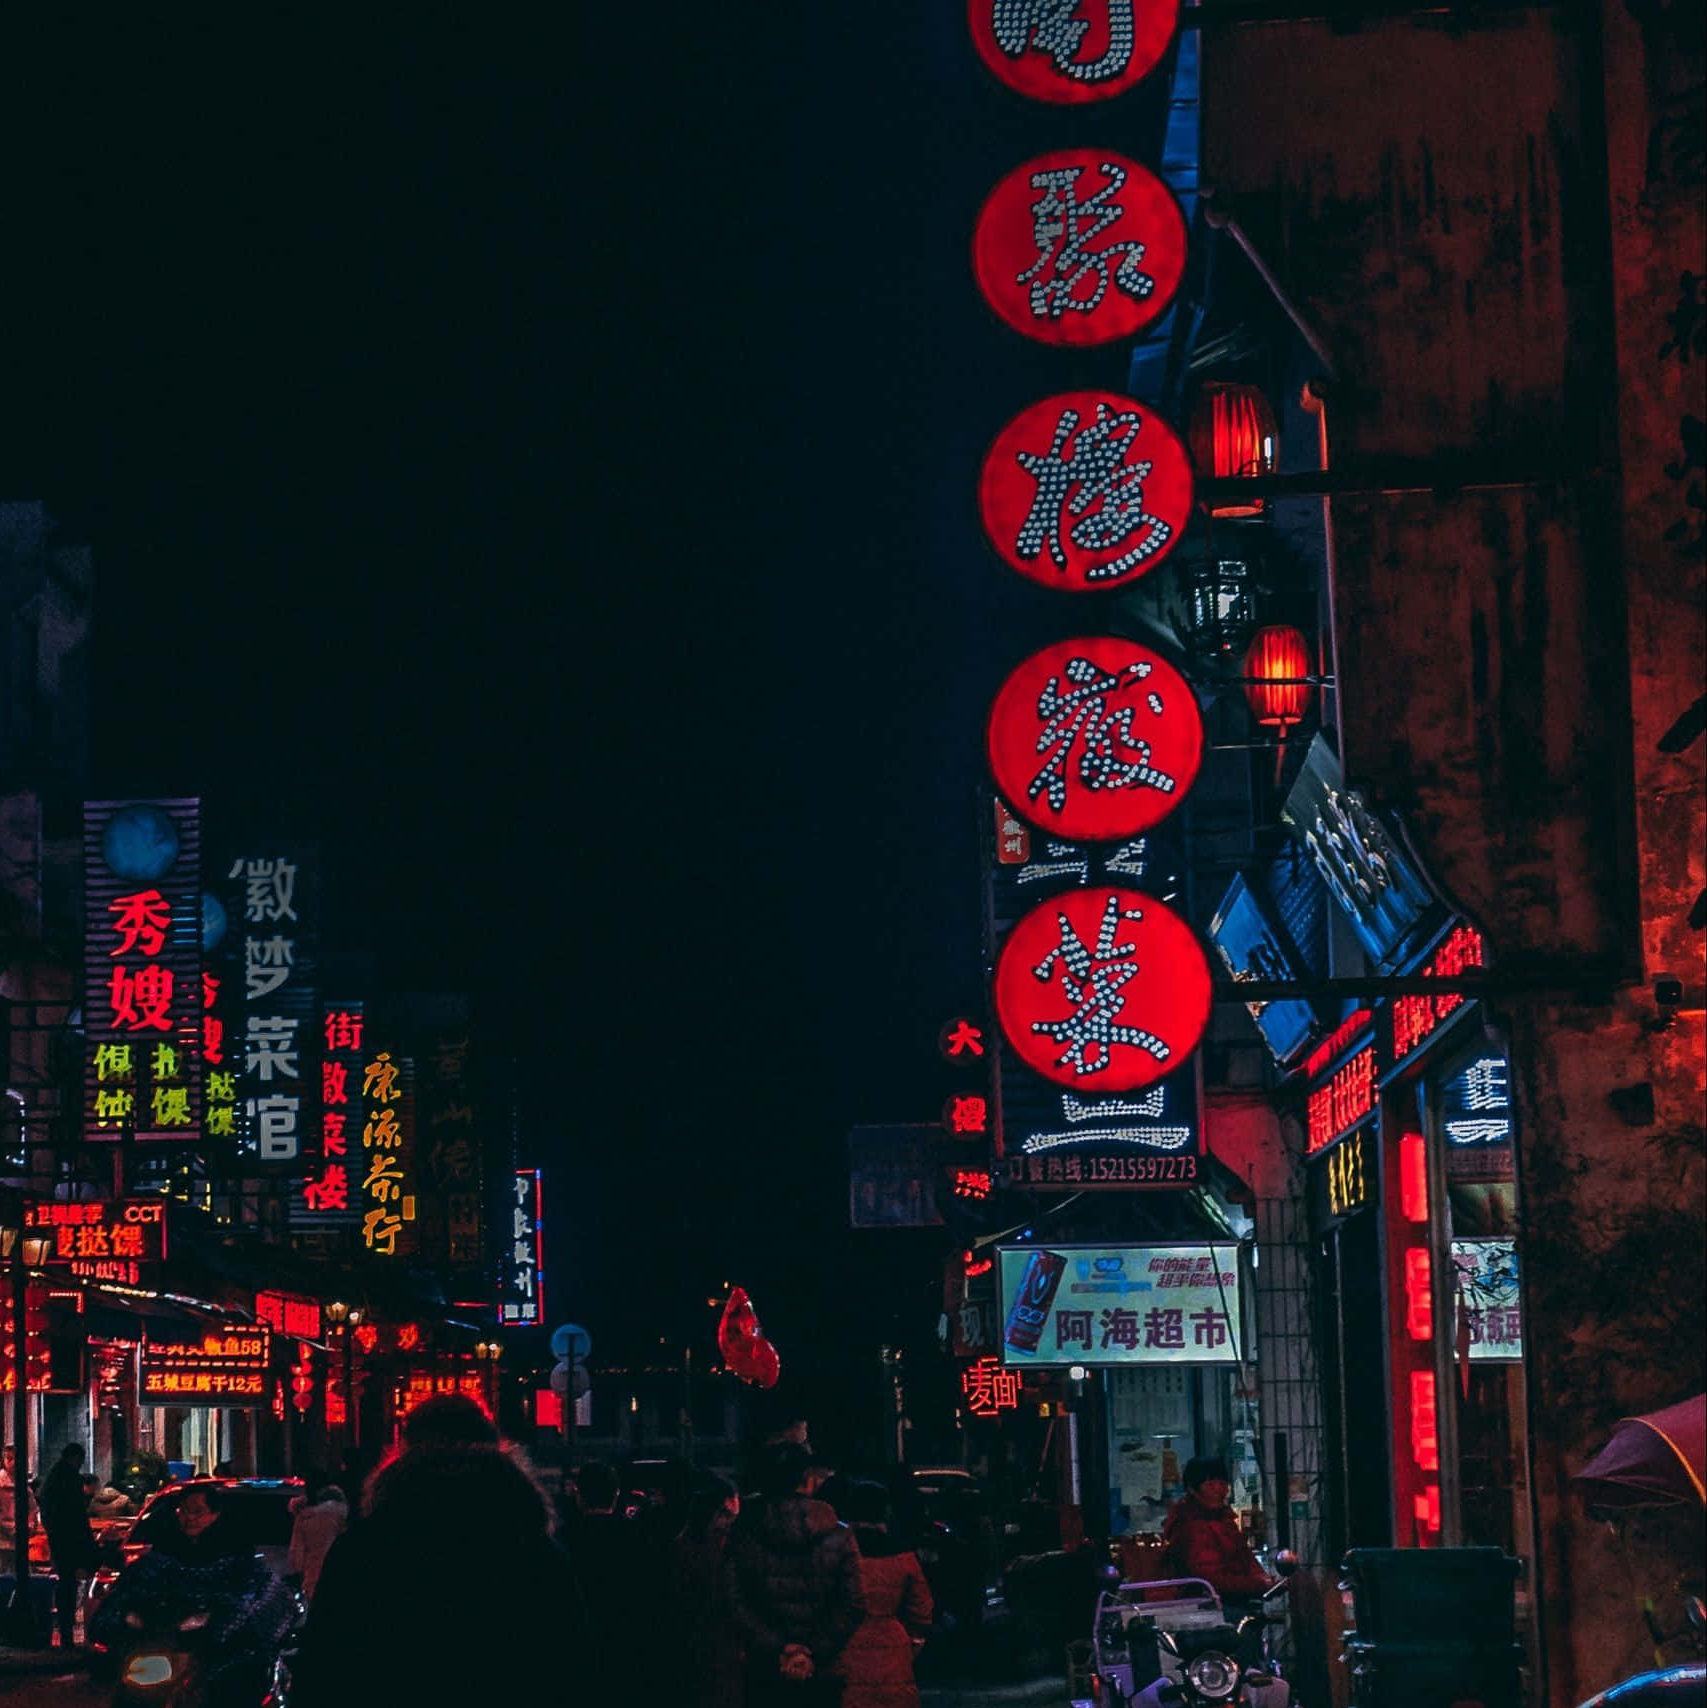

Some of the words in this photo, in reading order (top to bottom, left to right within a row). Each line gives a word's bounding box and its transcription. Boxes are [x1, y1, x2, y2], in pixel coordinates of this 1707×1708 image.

[106, 888, 175, 1032] 秀嫂
[1055, 1307, 1229, 1351] 阿海超市
